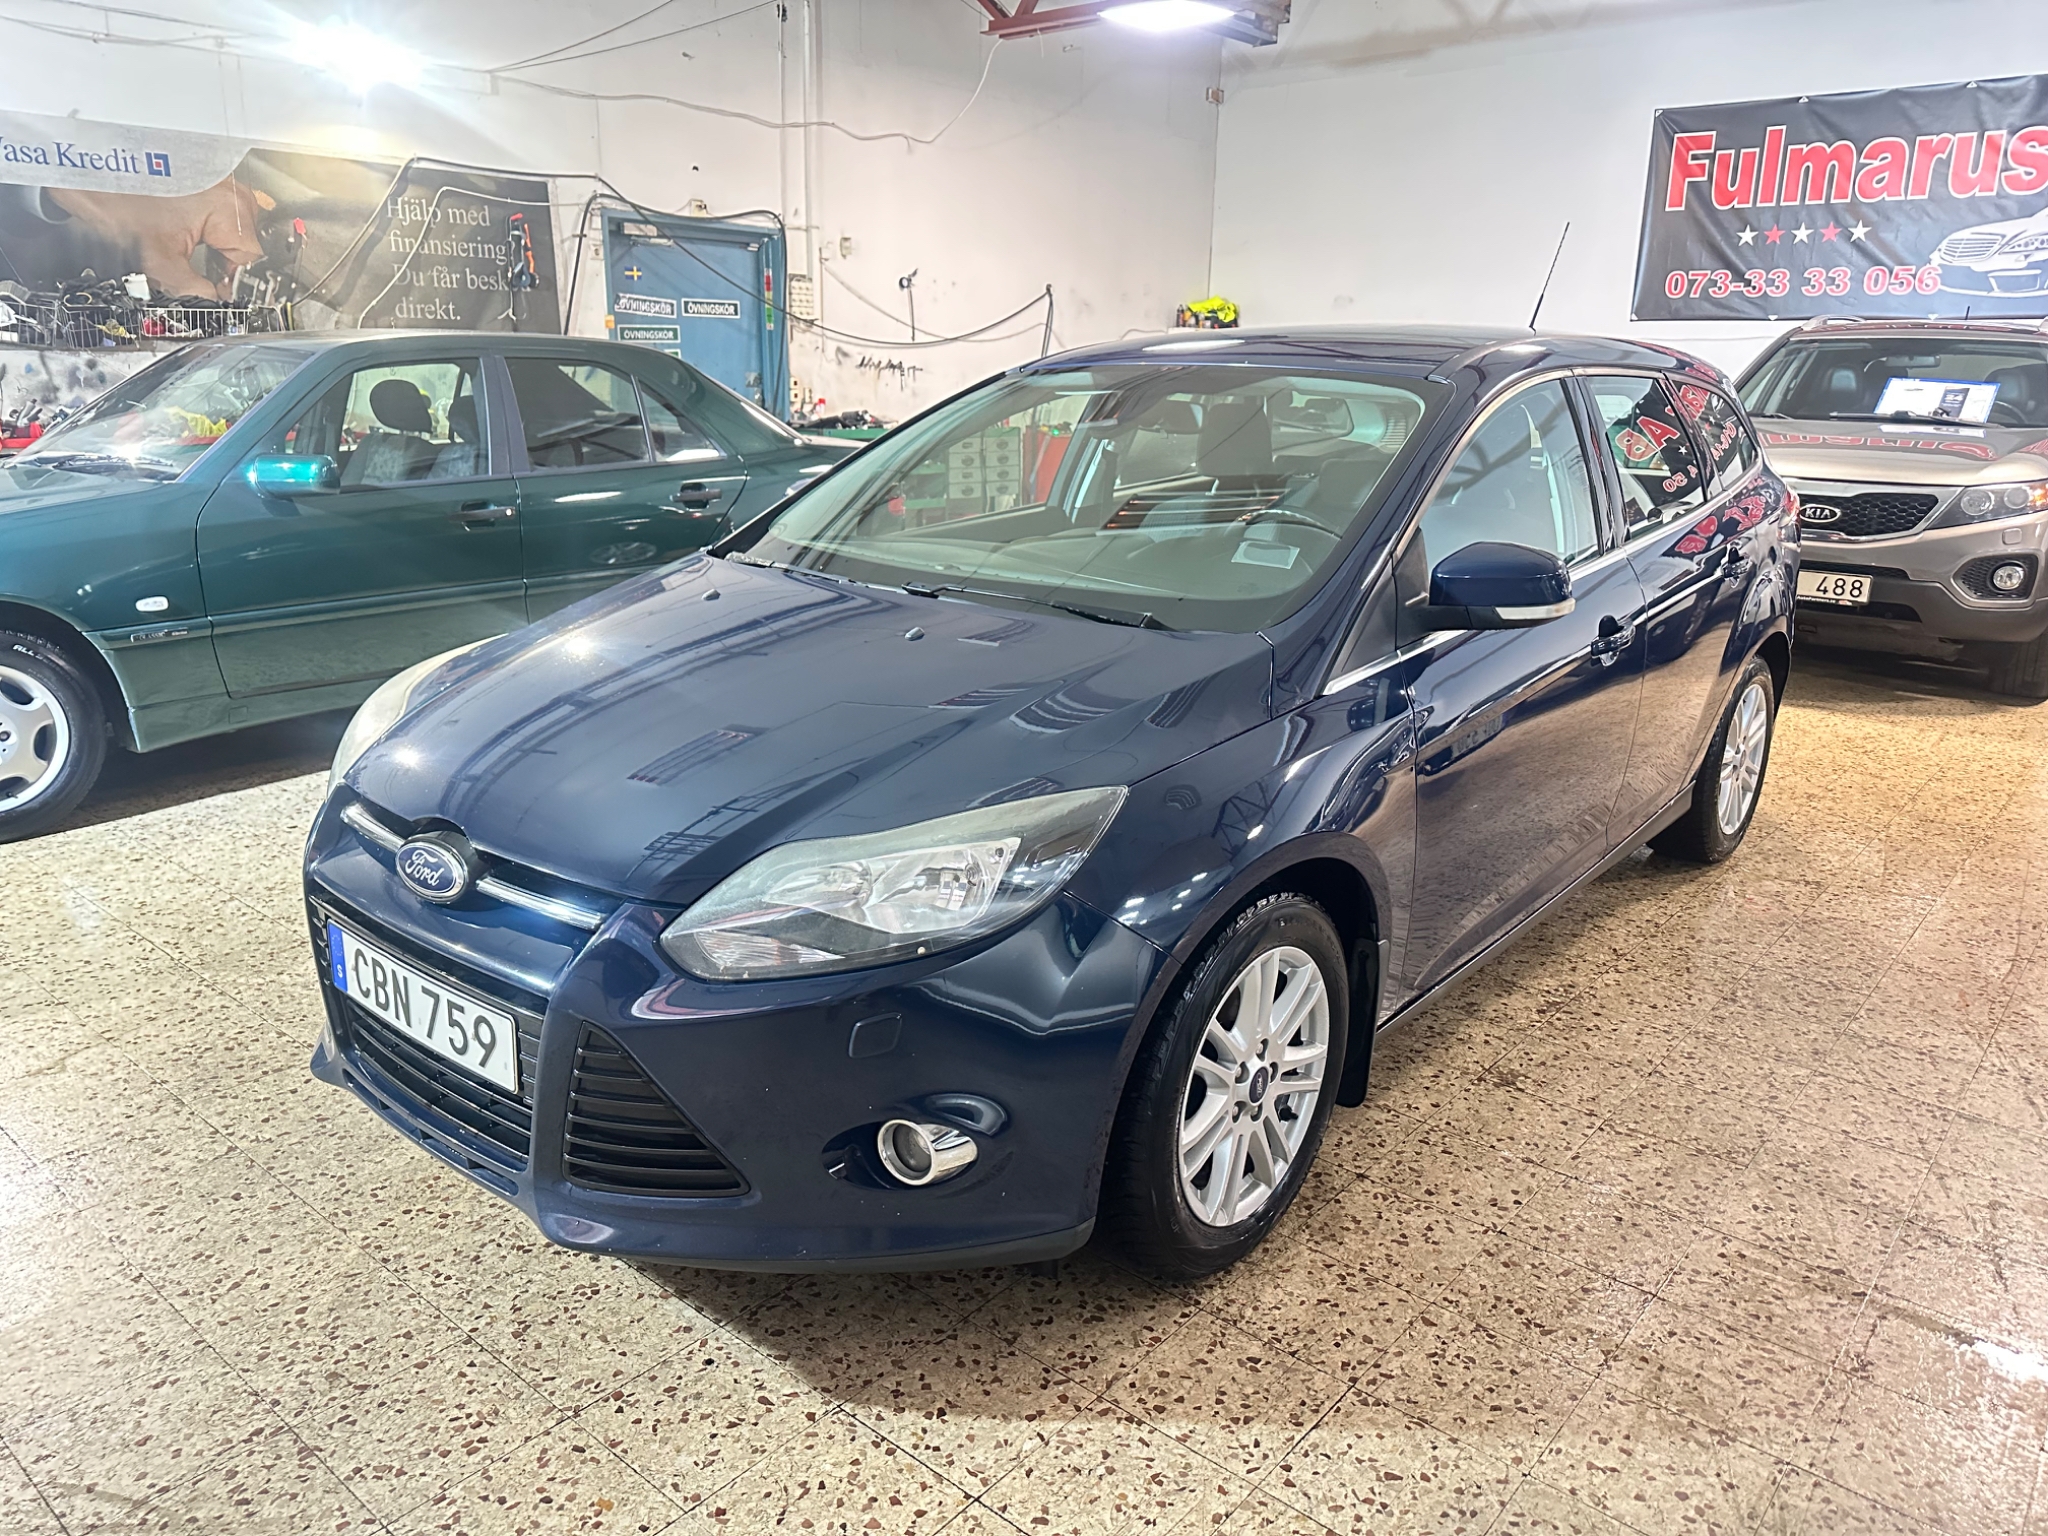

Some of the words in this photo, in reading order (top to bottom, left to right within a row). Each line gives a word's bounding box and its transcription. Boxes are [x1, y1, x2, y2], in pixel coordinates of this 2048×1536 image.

[0, 136, 50, 165] asa
[52, 141, 141, 174] Kredit
[1664, 124, 2048, 212] Fulmarus
[386, 196, 441, 228] Hjälp
[447, 205, 491, 227] med
[392, 263, 426, 286] Du
[432, 265, 461, 289] får
[465, 267, 531, 292] besk
[1664, 268, 1790, 298] 073-33
[1801, 266, 1852, 297] 33
[1862, 264, 1942, 296] 056
[394, 296, 461, 321] direkt.
[687, 301, 736, 315] ÖVNINGSKÖR
[623, 328, 674, 340] ÖVNINGSKÖR
[1805, 507, 1831, 519] KIA
[1815, 576, 1864, 598] 488
[404, 849, 445, 887] Ford
[336, 963, 344, 979] S
[353, 947, 413, 1029] CBN
[420, 984, 497, 1069] 759
